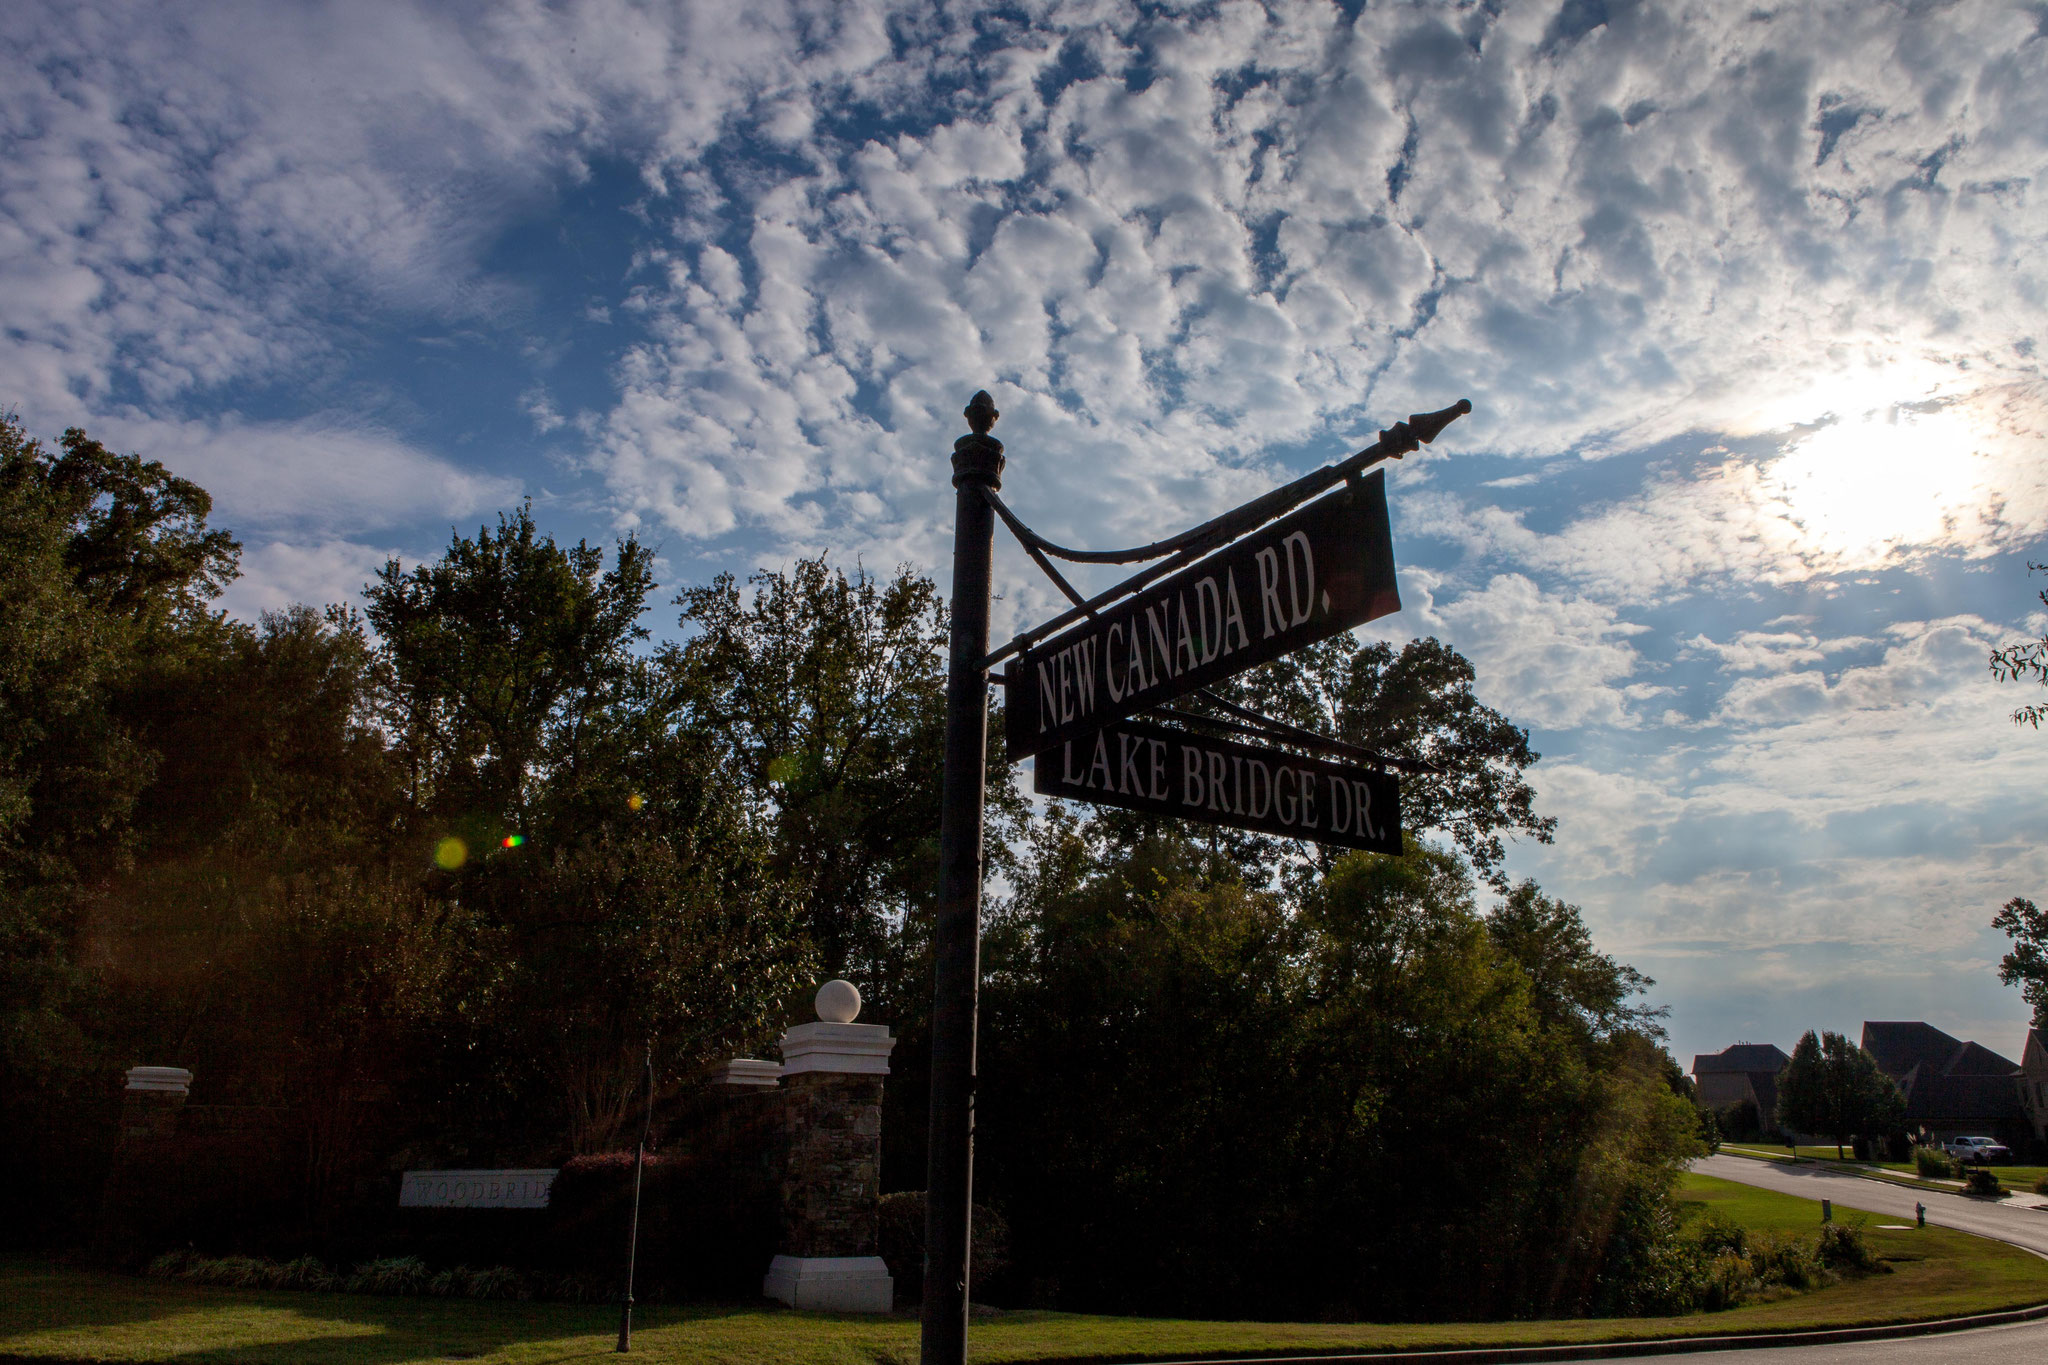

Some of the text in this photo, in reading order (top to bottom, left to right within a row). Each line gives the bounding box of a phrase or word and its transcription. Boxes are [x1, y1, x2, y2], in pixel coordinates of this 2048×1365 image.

[1037, 530, 1331, 734] NEW CANADA RD.
[1061, 729, 1386, 841] LAKE BRIDGE DR.
